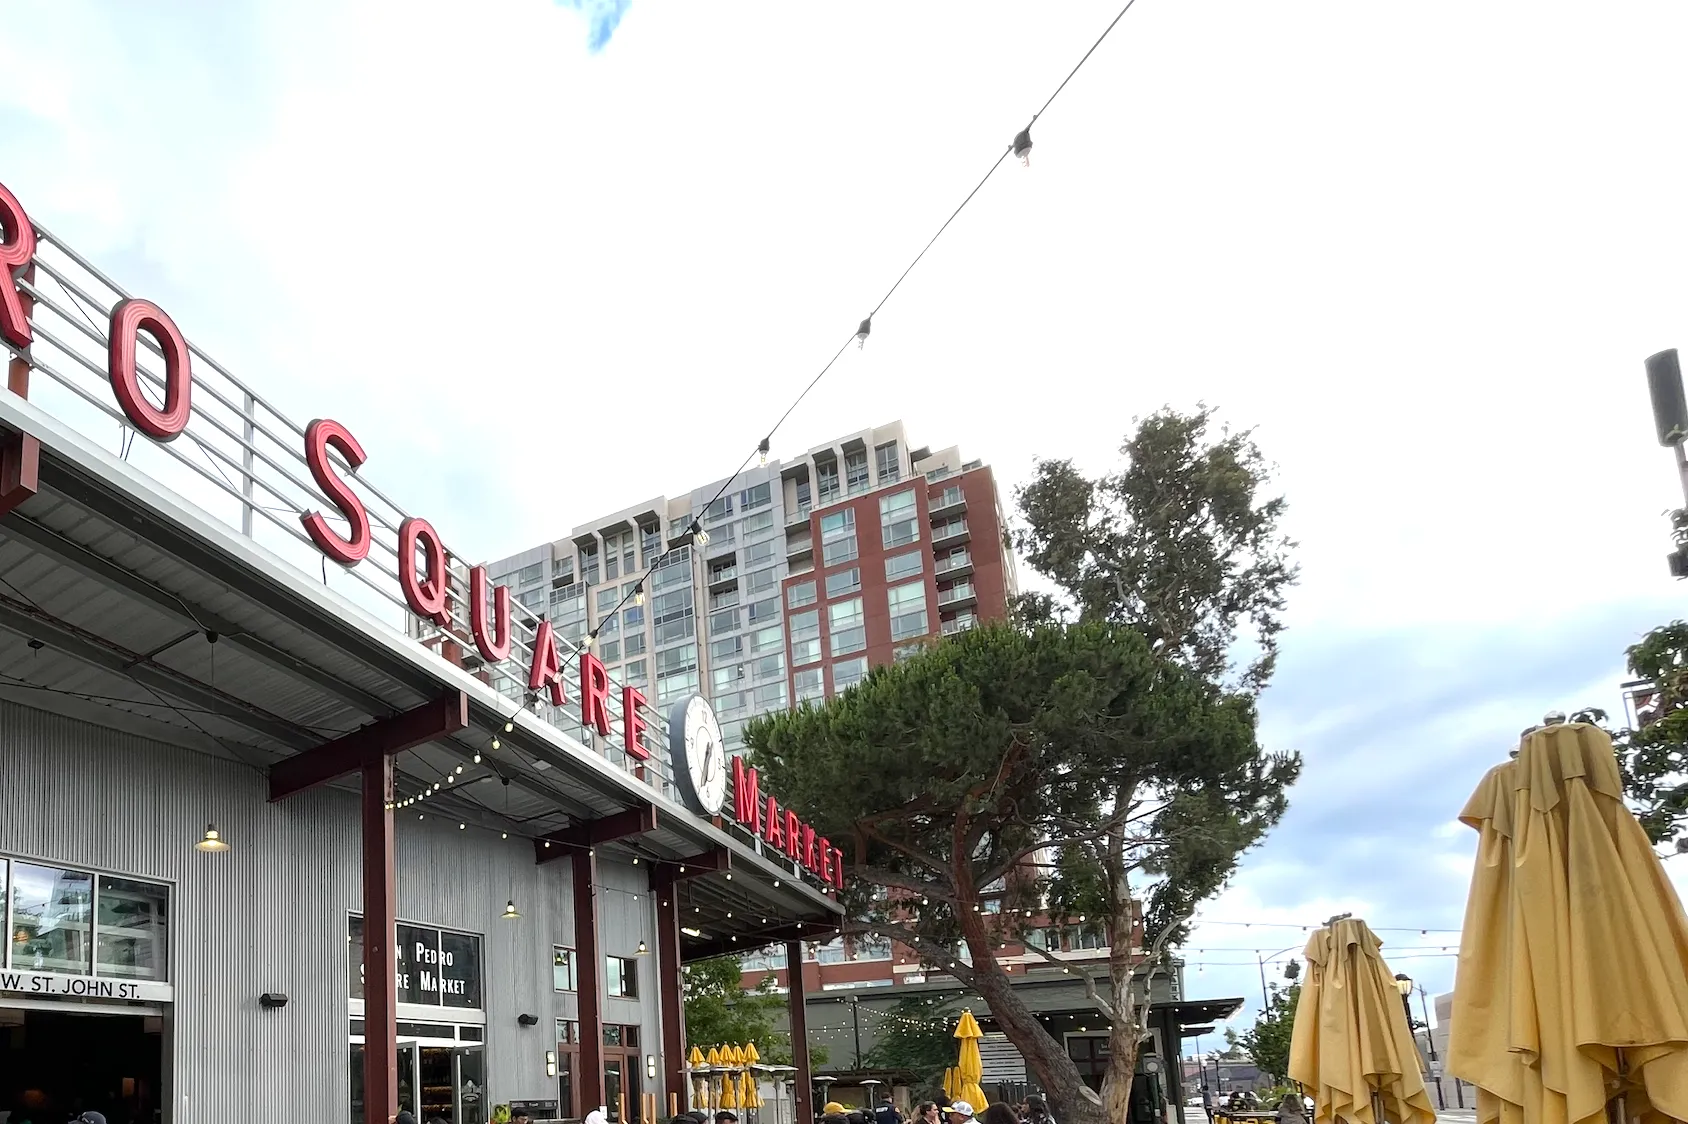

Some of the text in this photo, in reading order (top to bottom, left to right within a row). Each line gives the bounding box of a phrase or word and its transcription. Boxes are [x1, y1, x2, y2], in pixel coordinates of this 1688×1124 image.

[299, 418, 650, 762] SQUARE
[732, 755, 843, 890] MARKET
[415, 942, 454, 967] PEDRO
[1, 973, 141, 999] W. ST. JOHN ST.
[420, 970, 466, 995] MARKET
